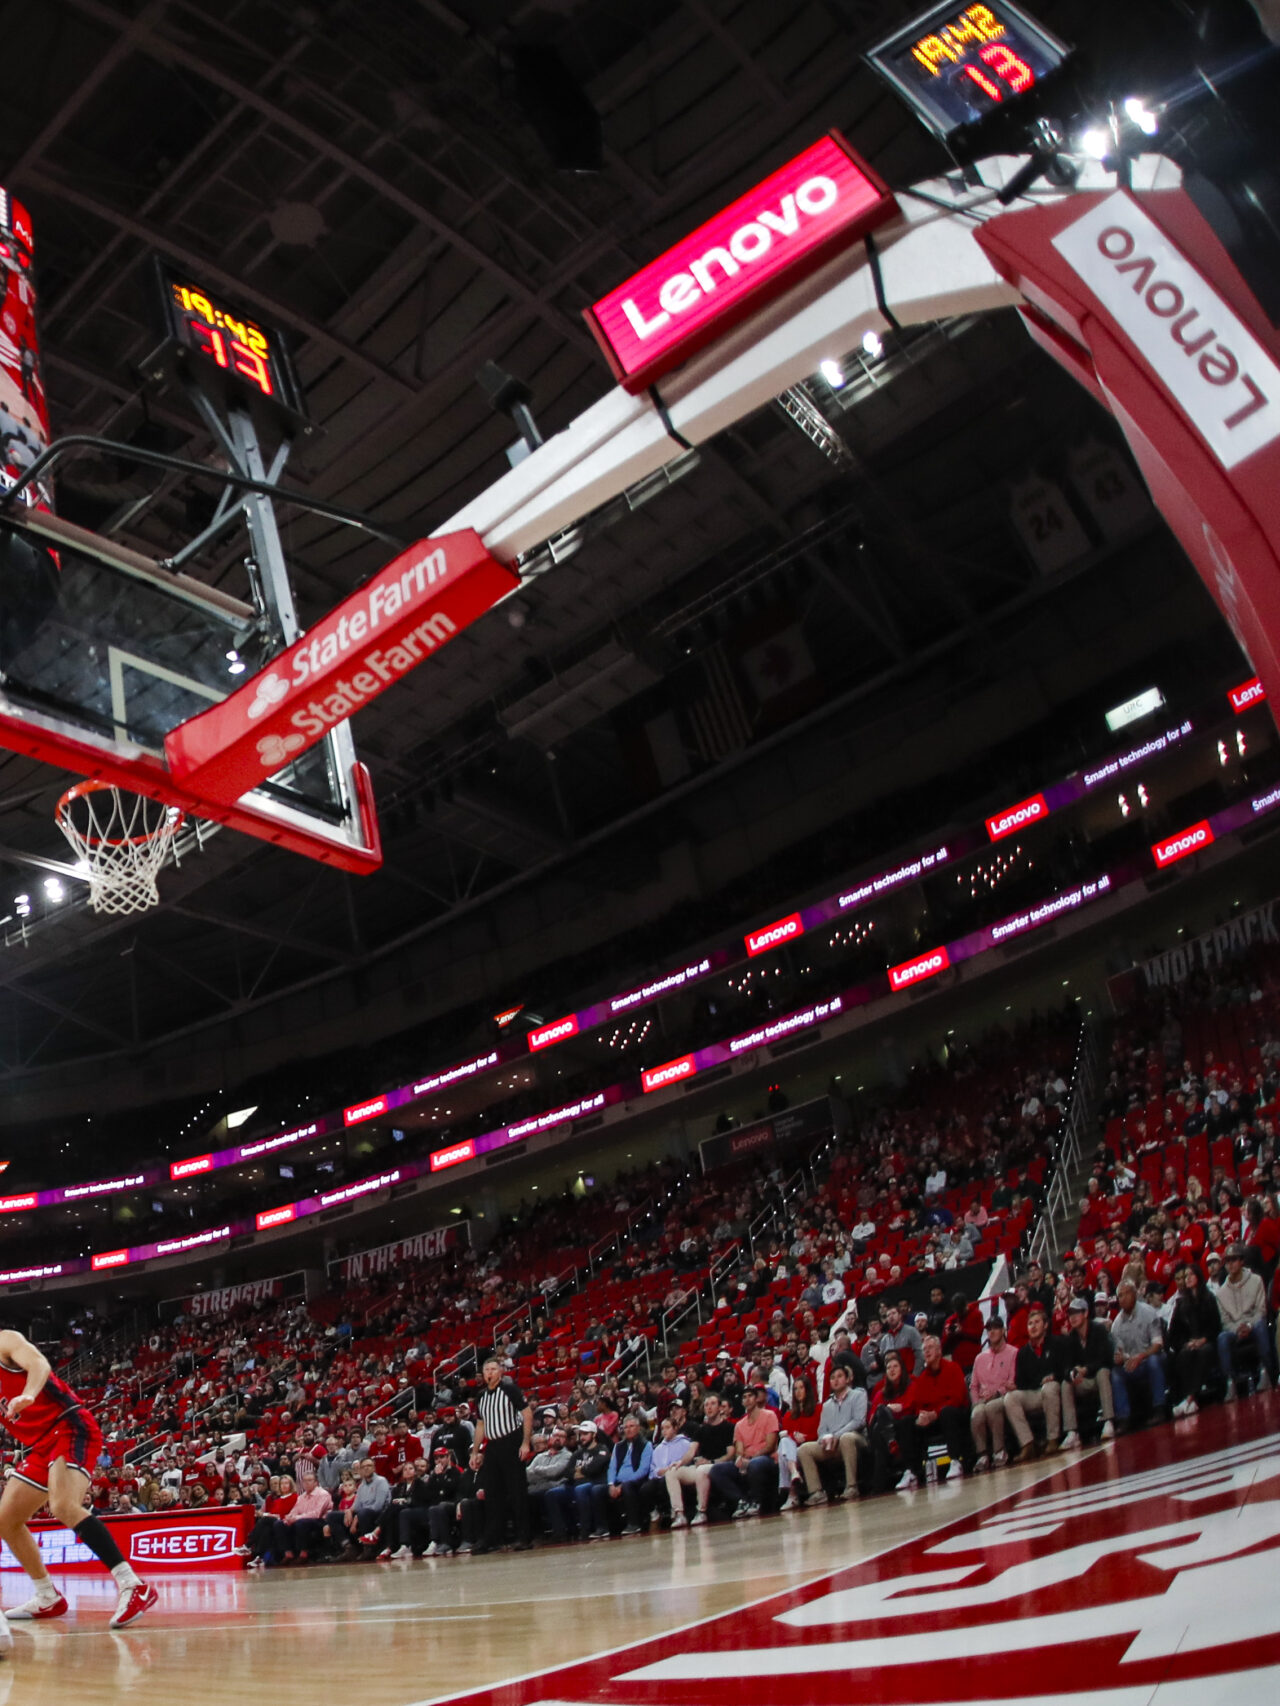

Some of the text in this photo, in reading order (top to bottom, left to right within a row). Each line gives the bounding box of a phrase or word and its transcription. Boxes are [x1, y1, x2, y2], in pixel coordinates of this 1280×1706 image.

[912, 4, 1006, 77] 19:42
[963, 43, 1035, 102] 13
[622, 175, 839, 341] Lenovo
[181, 287, 269, 359] 19:42
[1097, 226, 1269, 430] Lenovo
[1084, 721, 1191, 785] Smarter technology for all
[991, 803, 1040, 834] Lenovo
[1157, 830, 1205, 860] Lenovo
[839, 848, 947, 906] Smarter technology for all
[992, 876, 1109, 938] Smarter technology for all
[750, 922, 796, 950] Lenovo
[611, 960, 709, 1010] Smarter technology for all
[893, 956, 942, 984] Lenovo
[532, 1019, 573, 1046] Lenovo
[730, 998, 841, 1051] Smarter technology for all
[414, 1053, 497, 1094] Smarter technology for all
[646, 1062, 690, 1086] Lenovo
[347, 1102, 384, 1121] Lenovo
[508, 1094, 604, 1137] Smarter technology for all
[241, 1125, 316, 1156] Smarter technology for all
[732, 1131, 769, 1151] Lenovo
[174, 1160, 209, 1175] Lenovo
[434, 1146, 471, 1166] Lenovo
[65, 1187, 89, 1197] Smarter
[89, 1181, 124, 1192] technology
[135, 1176, 144, 1184] all
[321, 1171, 399, 1205] Smarter technology for all
[0, 1198, 34, 1209] Lenovo
[259, 1209, 292, 1225] Lenovo
[157, 1242, 181, 1252] Smarter
[181, 1233, 212, 1247] technology
[221, 1227, 229, 1235] all
[95, 1254, 126, 1266] Lenovo
[138, 1533, 228, 1555] SHEETZ
